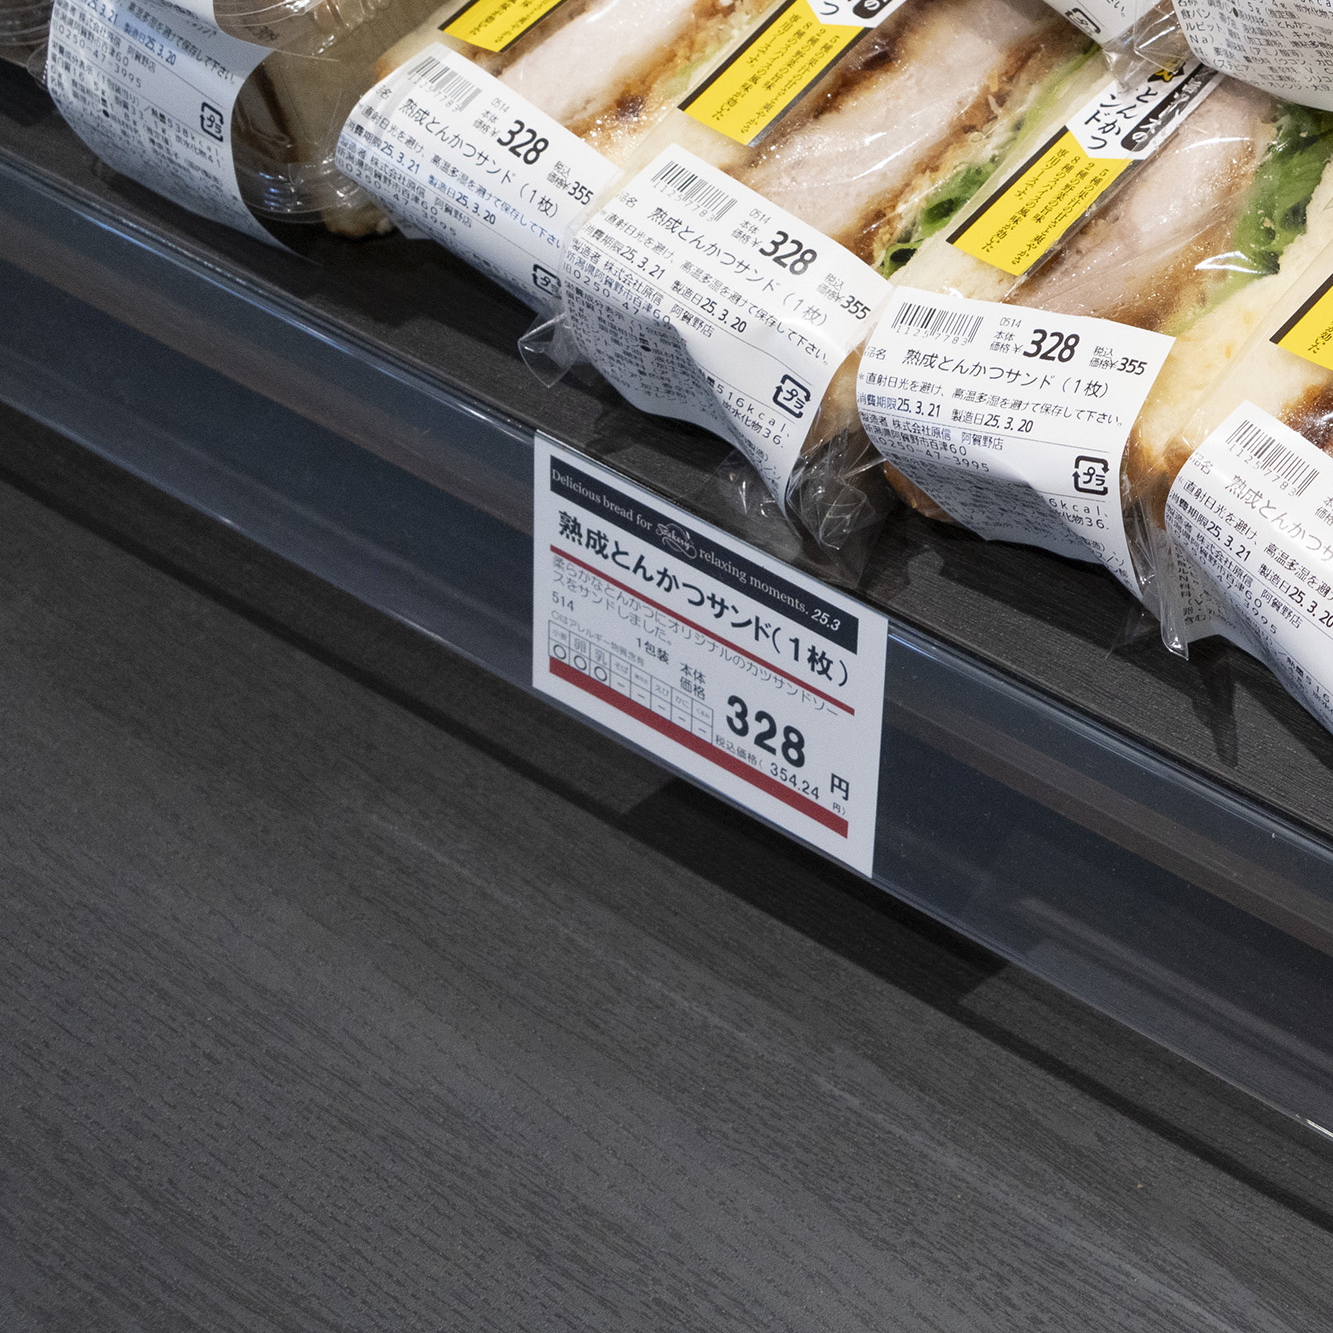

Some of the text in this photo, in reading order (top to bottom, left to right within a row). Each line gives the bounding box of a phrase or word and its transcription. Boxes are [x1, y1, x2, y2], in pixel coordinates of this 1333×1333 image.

[497, 119, 594, 206] 328 355
[759, 229, 872, 321] 328 355
[902, 347, 1112, 400] 熟成とんかつサンド(1枚)
[1023, 328, 1147, 376] 328 355
[551, 466, 601, 507] Delicious
[603, 494, 634, 522] bread
[636, 512, 653, 531] for
[699, 547, 747, 585] relaxing
[749, 573, 810, 615] moments.
[812, 608, 841, 633] 25.3
[552, 591, 575, 613] 514
[557, 509, 850, 687] 熟成とんかつサンド(1枚)
[635, 635, 670, 667] 1包装
[680, 661, 706, 685] 本体
[680, 675, 706, 701] 価格
[726, 694, 806, 769] 328
[830, 773, 850, 801] 円
